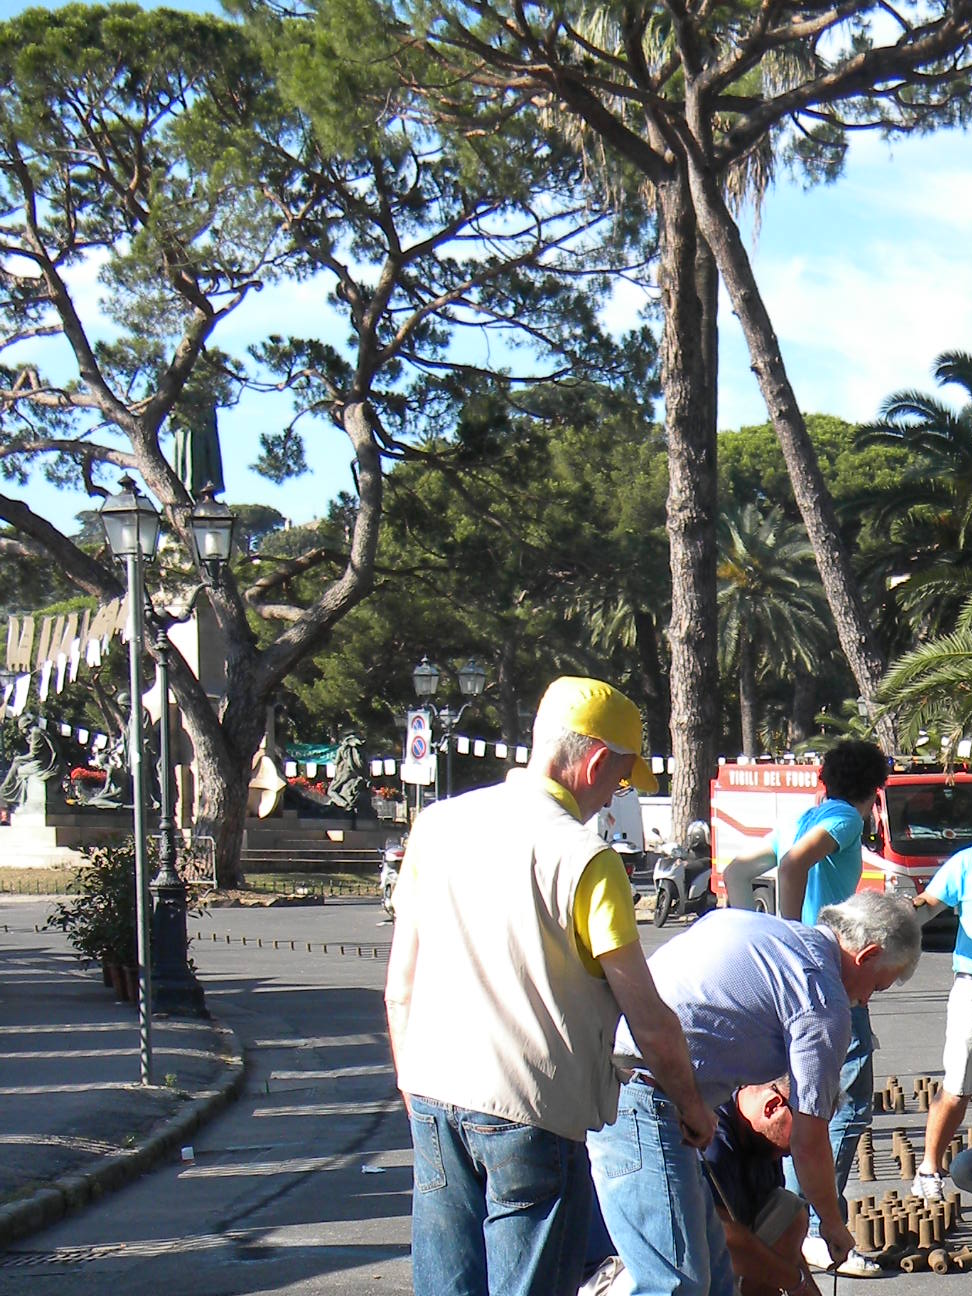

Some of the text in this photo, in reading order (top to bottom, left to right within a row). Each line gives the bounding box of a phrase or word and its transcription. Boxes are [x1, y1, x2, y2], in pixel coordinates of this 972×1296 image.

[729, 770, 818, 788] VIGILI DEL FUOCO
